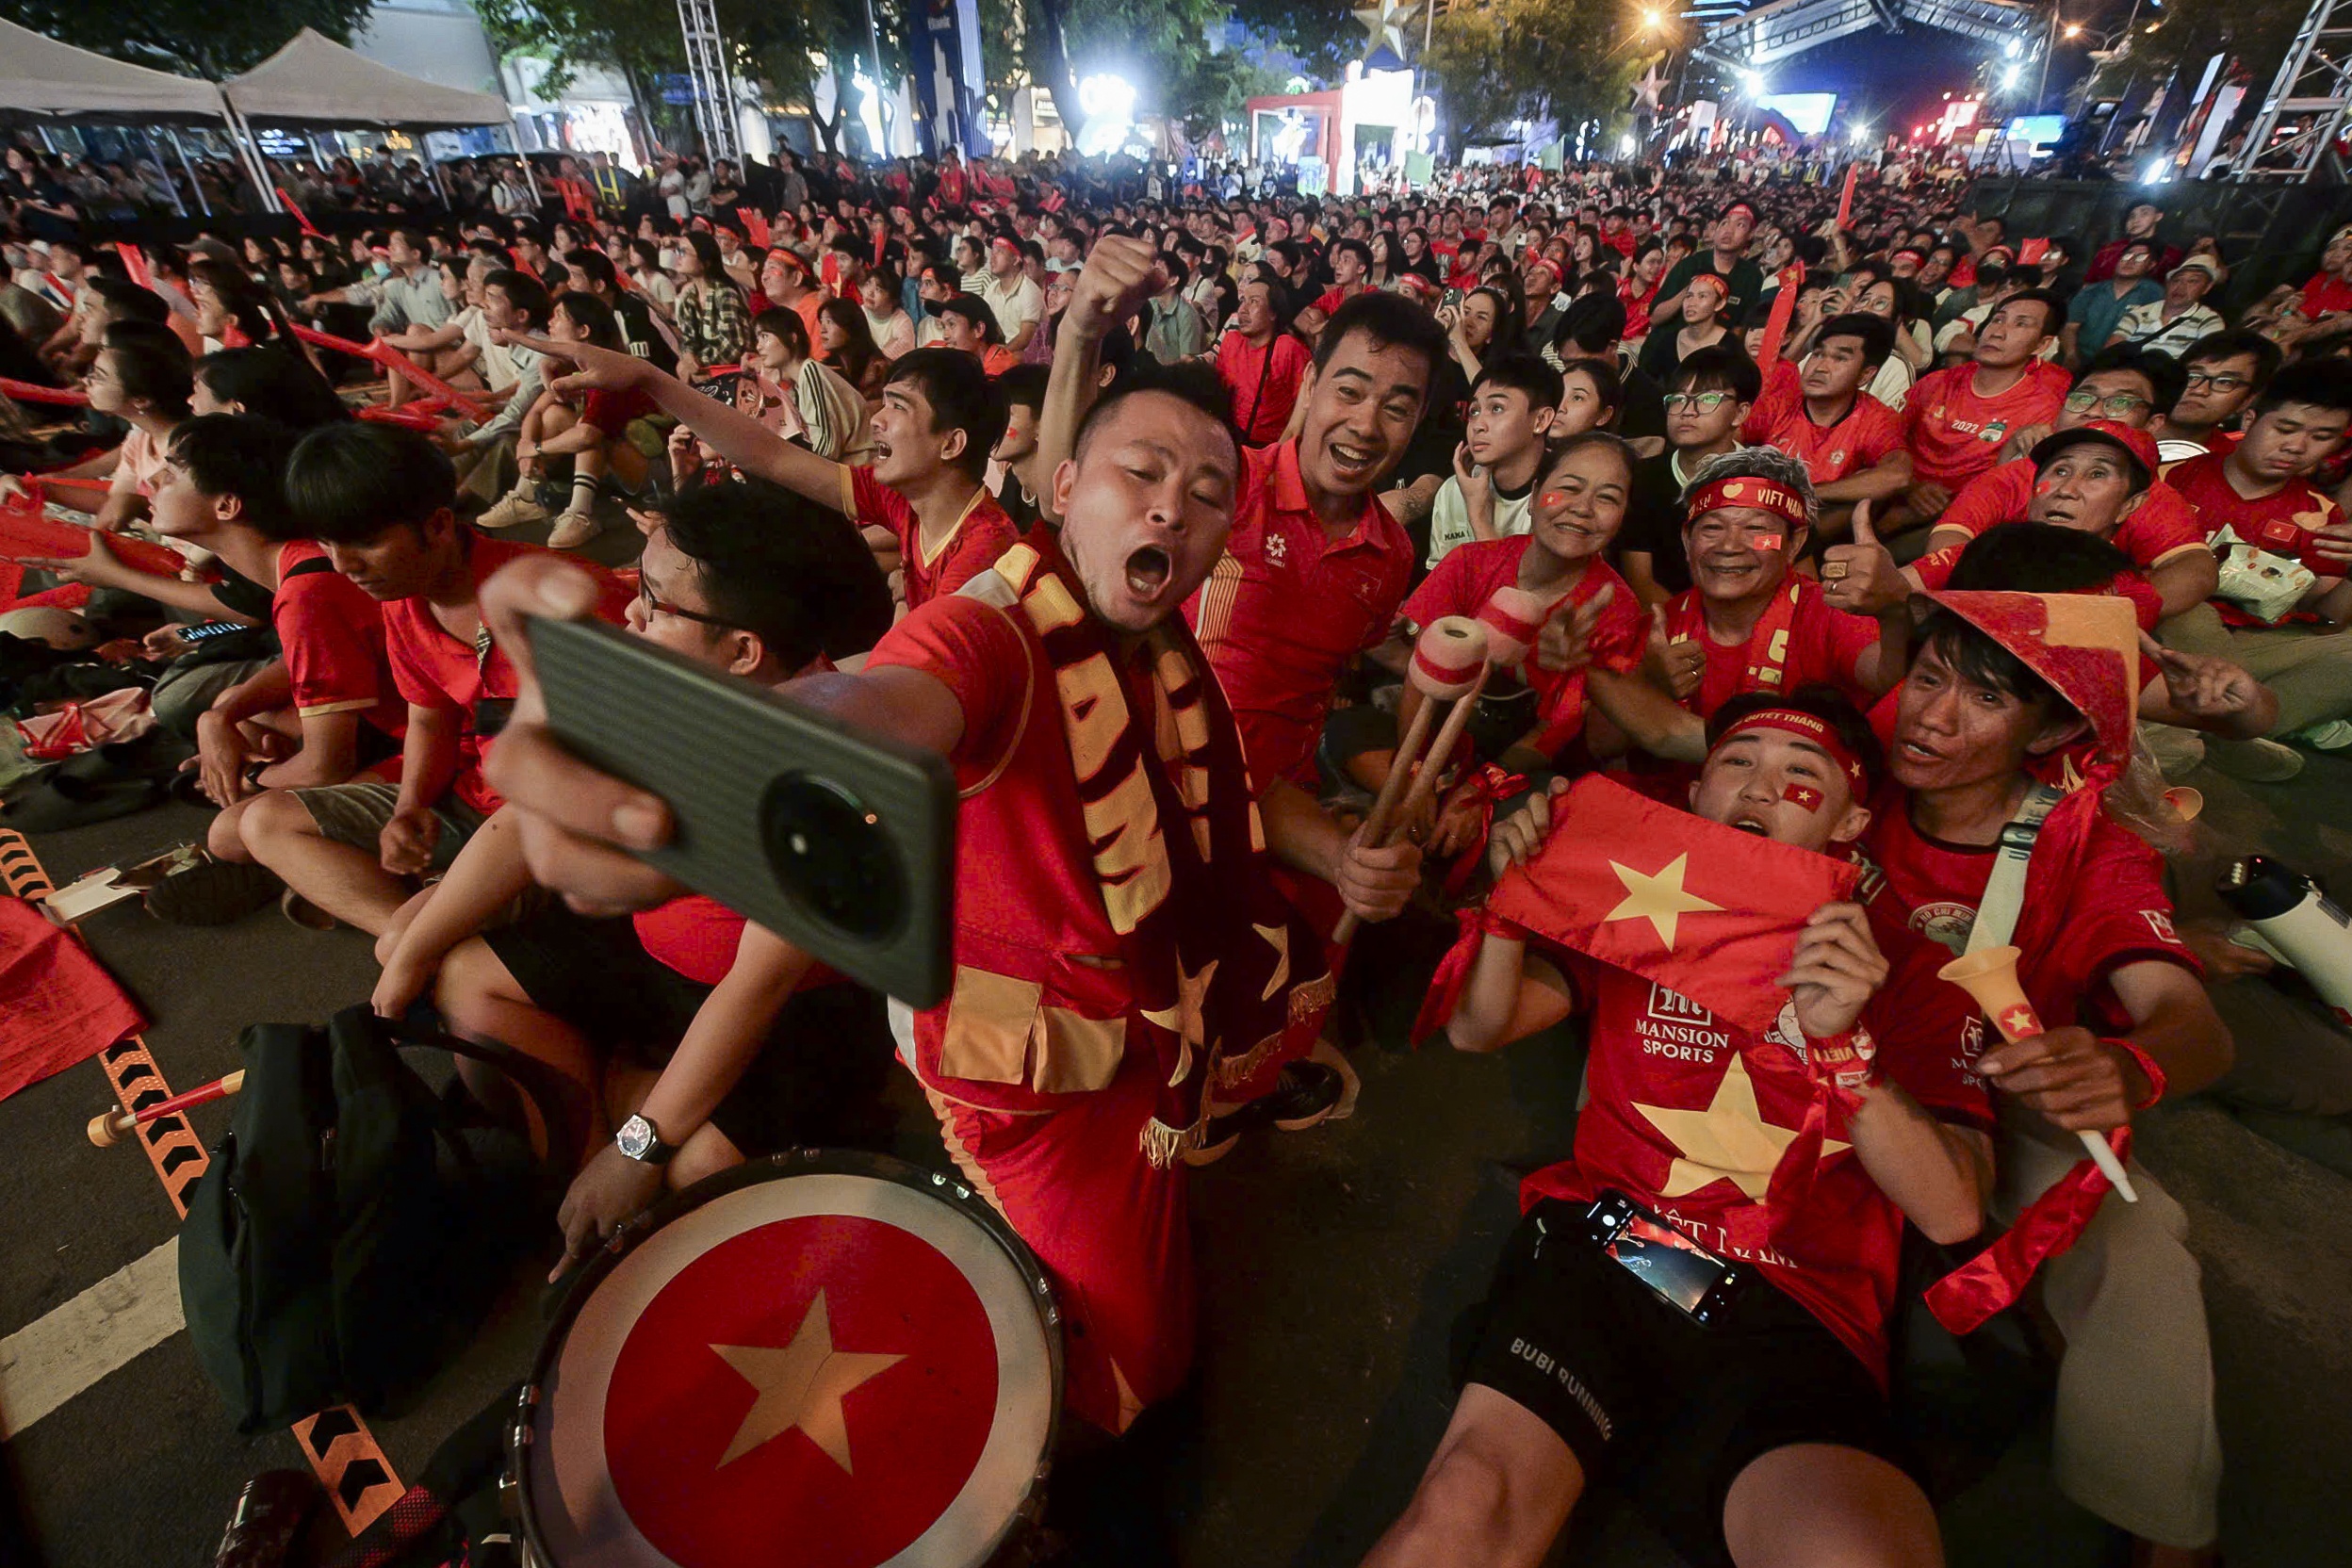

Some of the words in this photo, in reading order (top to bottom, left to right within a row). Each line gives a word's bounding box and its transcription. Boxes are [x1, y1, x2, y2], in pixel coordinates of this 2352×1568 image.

[1952, 419, 1979, 433] 2022
[1636, 1019, 1730, 1049] MANSION
[1642, 1038, 1714, 1064] SPORTS
[1511, 1337, 1555, 1375] BUBI
